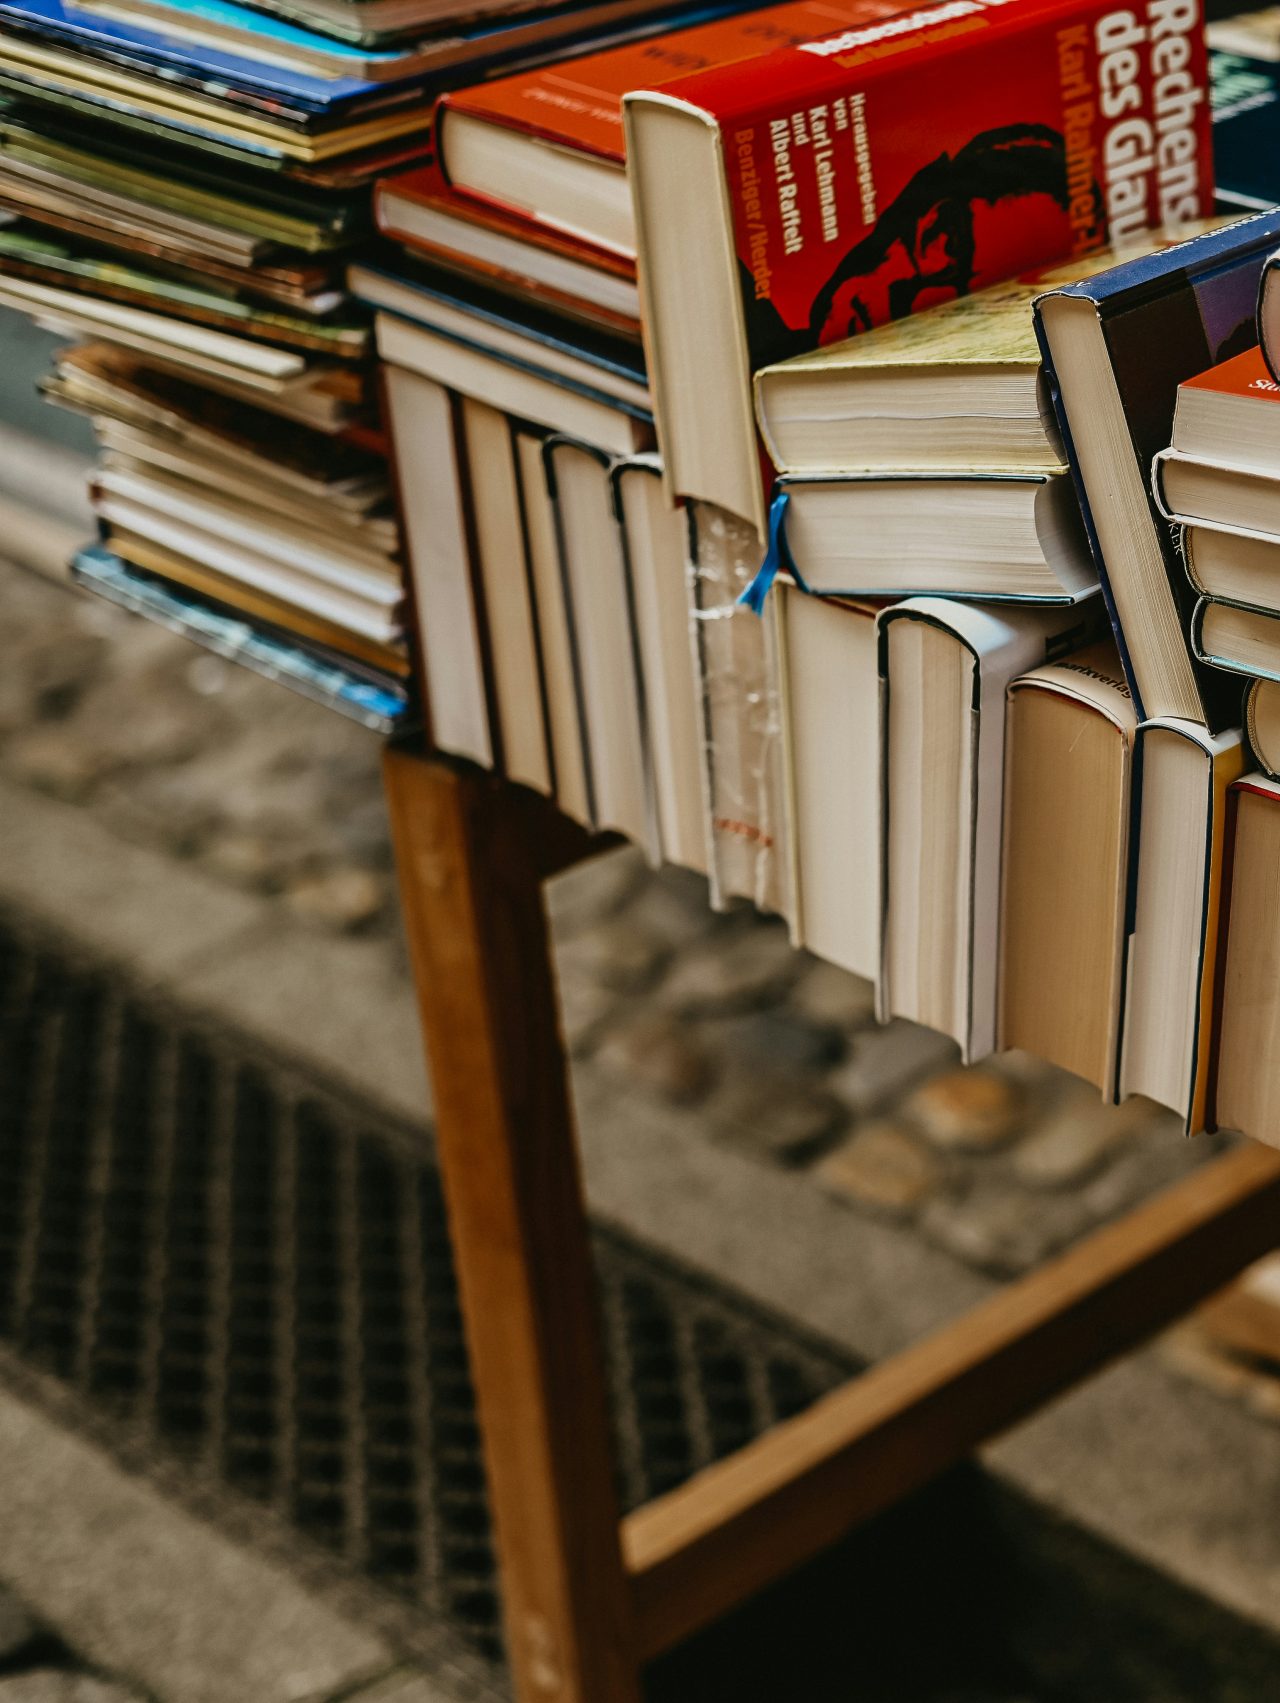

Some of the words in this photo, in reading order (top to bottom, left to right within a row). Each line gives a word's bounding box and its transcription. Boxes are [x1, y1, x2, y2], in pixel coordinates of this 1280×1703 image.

[1057, 24, 1092, 101] Karl
[1094, 11, 1146, 119] des
[791, 112, 811, 147] und
[809, 104, 833, 150] Karl
[832, 97, 849, 132] von
[769, 119, 795, 184] Albert
[849, 92, 877, 226] Herausgegeben
[779, 183, 804, 256] Raffelt
[814, 149, 839, 243] Lehmann
